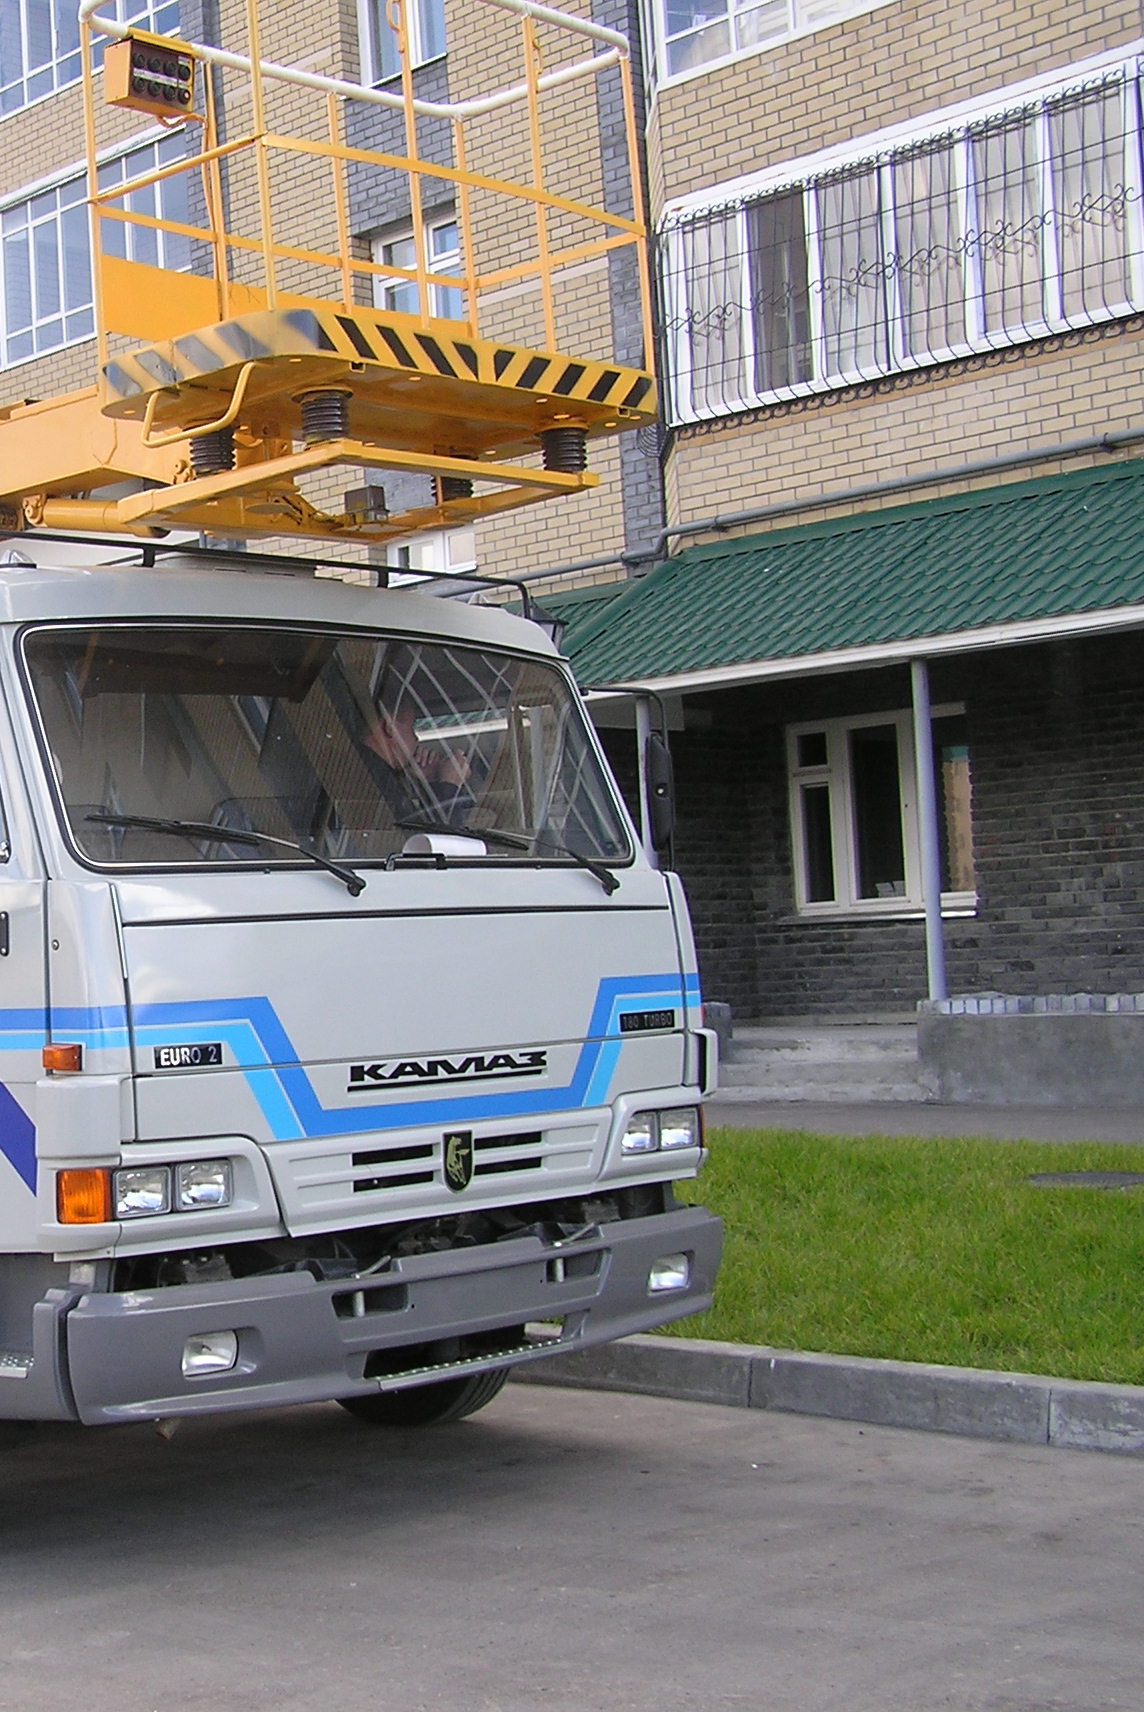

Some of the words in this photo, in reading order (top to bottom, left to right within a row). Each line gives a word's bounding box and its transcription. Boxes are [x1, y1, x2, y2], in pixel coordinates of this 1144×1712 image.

[644, 1012, 673, 1028] TURBO
[160, 1047, 202, 1066] EURO
[208, 1046, 217, 1063] 2
[350, 1050, 547, 1083] КАМАЗ
